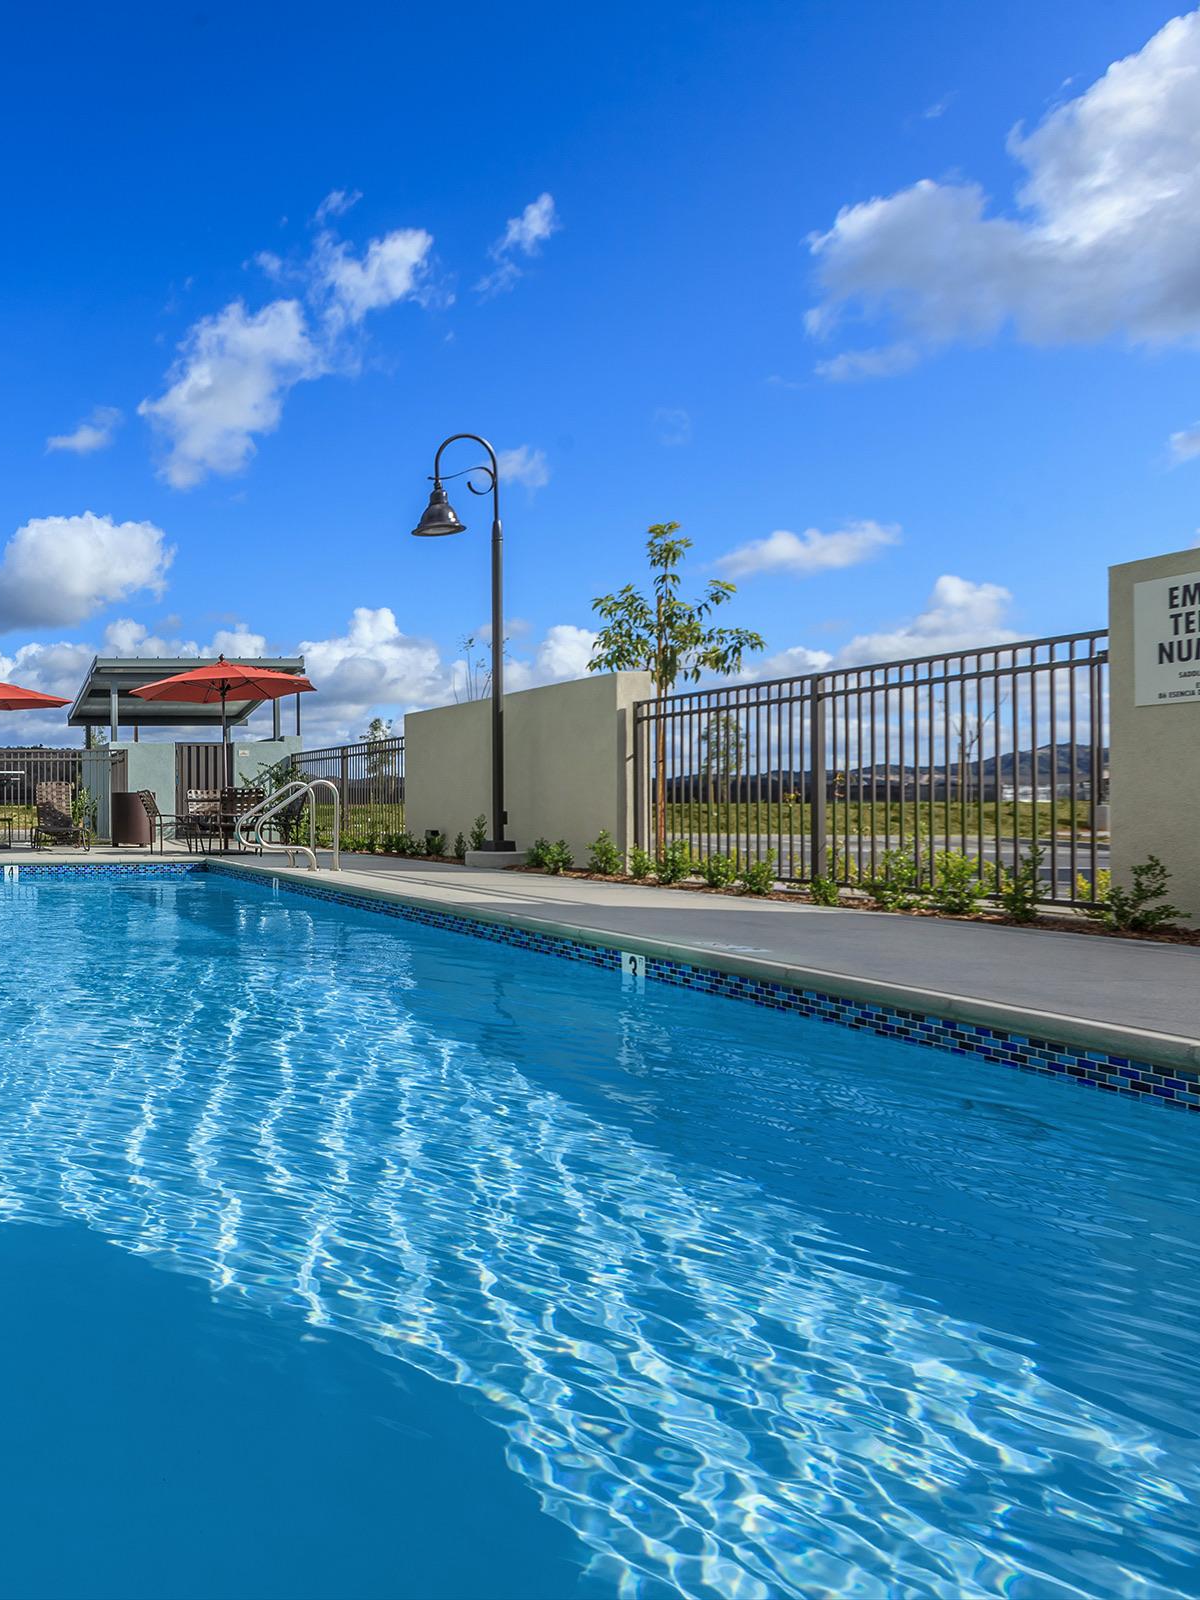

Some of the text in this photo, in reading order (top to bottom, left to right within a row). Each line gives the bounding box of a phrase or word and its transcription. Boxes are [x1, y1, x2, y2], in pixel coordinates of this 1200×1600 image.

[1168, 582, 1200, 609] EM
[1169, 610, 1200, 635] TE
[1158, 638, 1200, 664] NU
